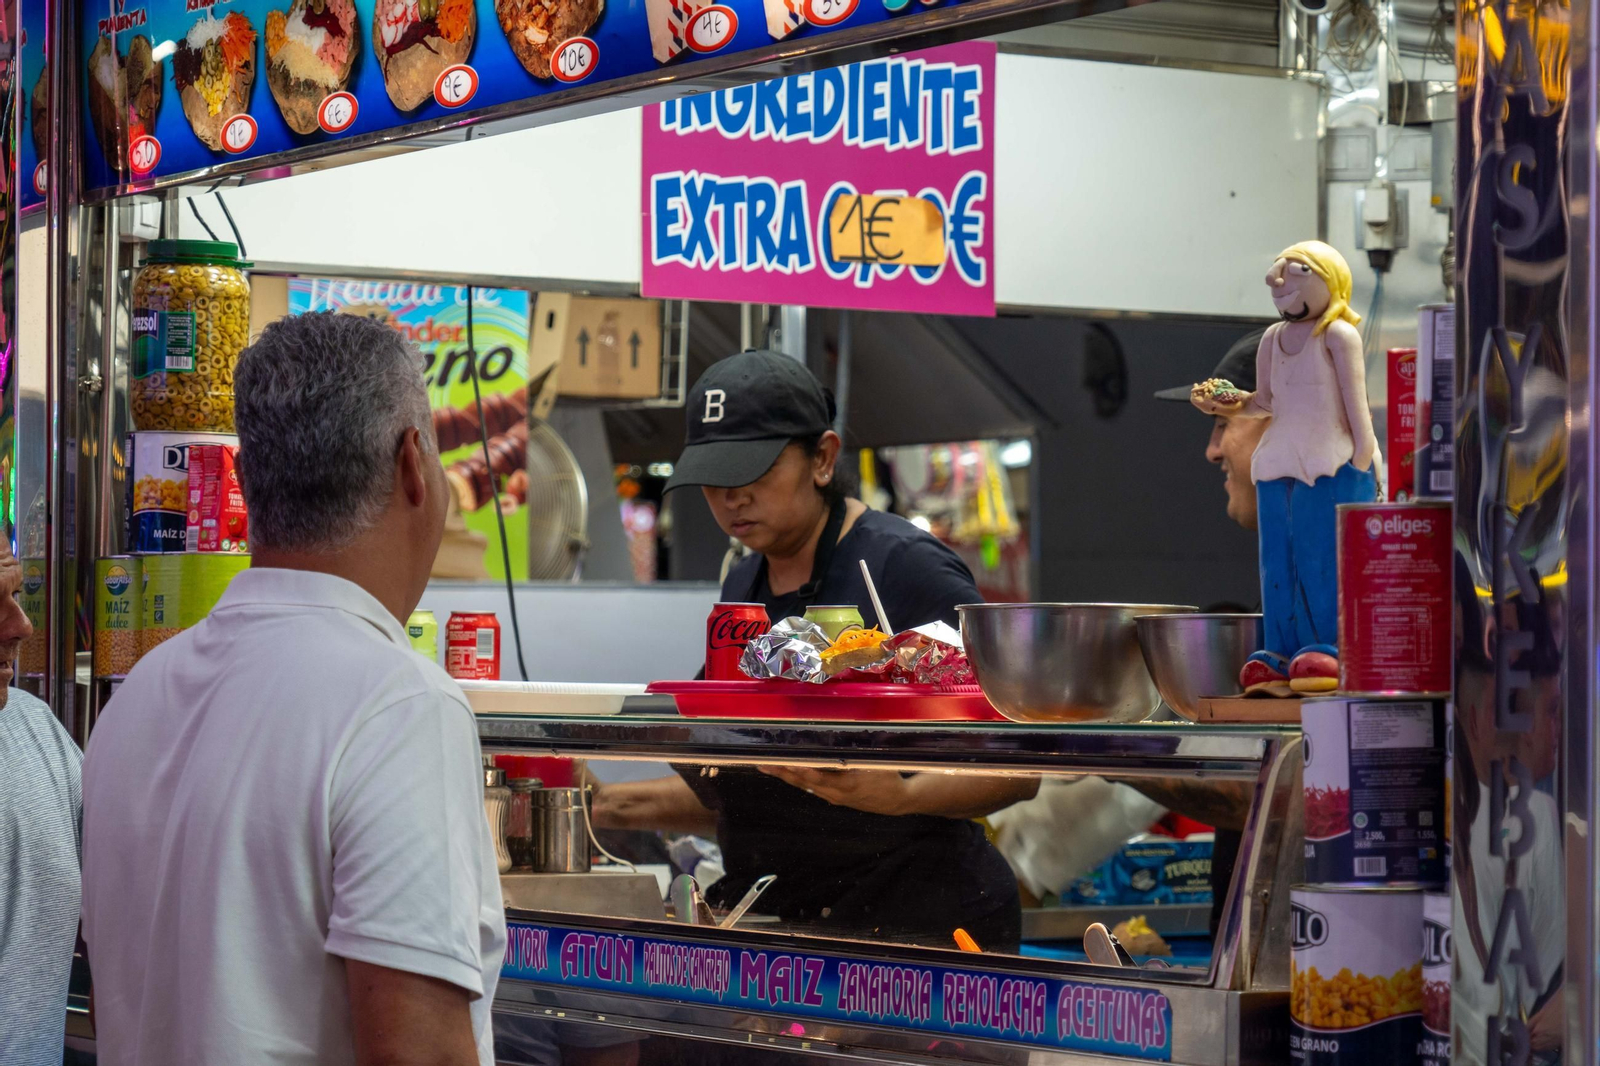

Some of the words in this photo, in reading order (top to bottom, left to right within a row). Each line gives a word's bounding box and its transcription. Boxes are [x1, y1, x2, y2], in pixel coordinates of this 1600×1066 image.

[703, 11, 721, 39] 4€
[651, 170, 816, 274] EXTRA
[838, 195, 904, 262] 1€
[702, 388, 726, 423] B
[153, 528, 178, 539] MAÍZ
[1384, 514, 1432, 537] eliges
[105, 597, 130, 614] MAÍZ
[517, 927, 549, 972] YORK
[560, 932, 634, 984] ATUN
[643, 941, 676, 987] PALITOS
[676, 945, 688, 988] DE
[688, 946, 731, 1001] CANGREJO
[740, 948, 825, 1006] MAIZ
[837, 962, 933, 1023] ZANAHORIA
[943, 972, 1047, 1037] REMOLACHA
[1057, 984, 1168, 1050] ACEITUNAS
[1301, 1037, 1339, 1054] GRANO
